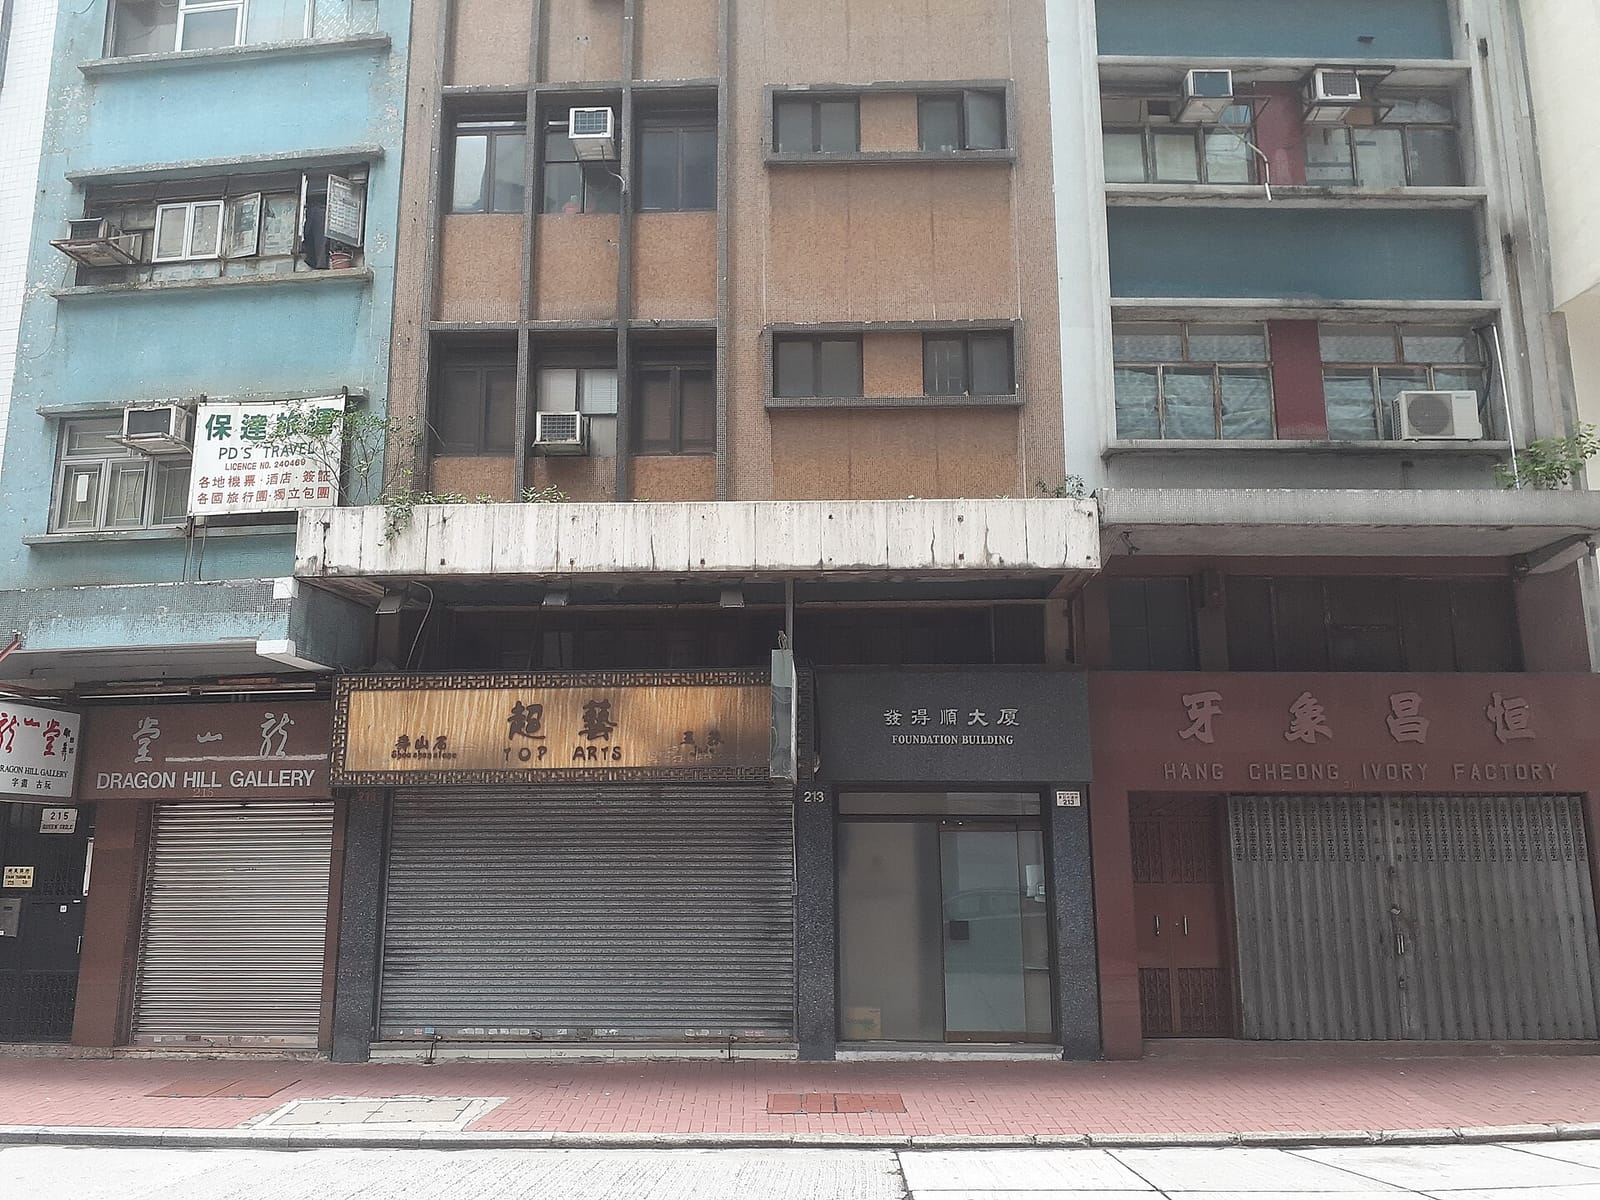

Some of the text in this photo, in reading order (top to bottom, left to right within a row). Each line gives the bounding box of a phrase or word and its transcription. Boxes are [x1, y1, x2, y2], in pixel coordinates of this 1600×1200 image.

[264, 441, 317, 458] TRAVEL
[225, 462, 257, 471] LICENCE
[260, 461, 272, 470] NO.
[892, 735, 1013, 745] FOUNDATION BUILDING
[503, 745, 622, 762] TOP ARTS
[0, 764, 69, 778] RAGON HILL GALLERY
[1163, 762, 1559, 781] HANG CHEONG IVORY FACTORY
[96, 769, 316, 790] DRAGON HILL GALLERY
[192, 788, 214, 798] 215
[804, 791, 825, 803] 213
[50, 811, 69, 821] 215
